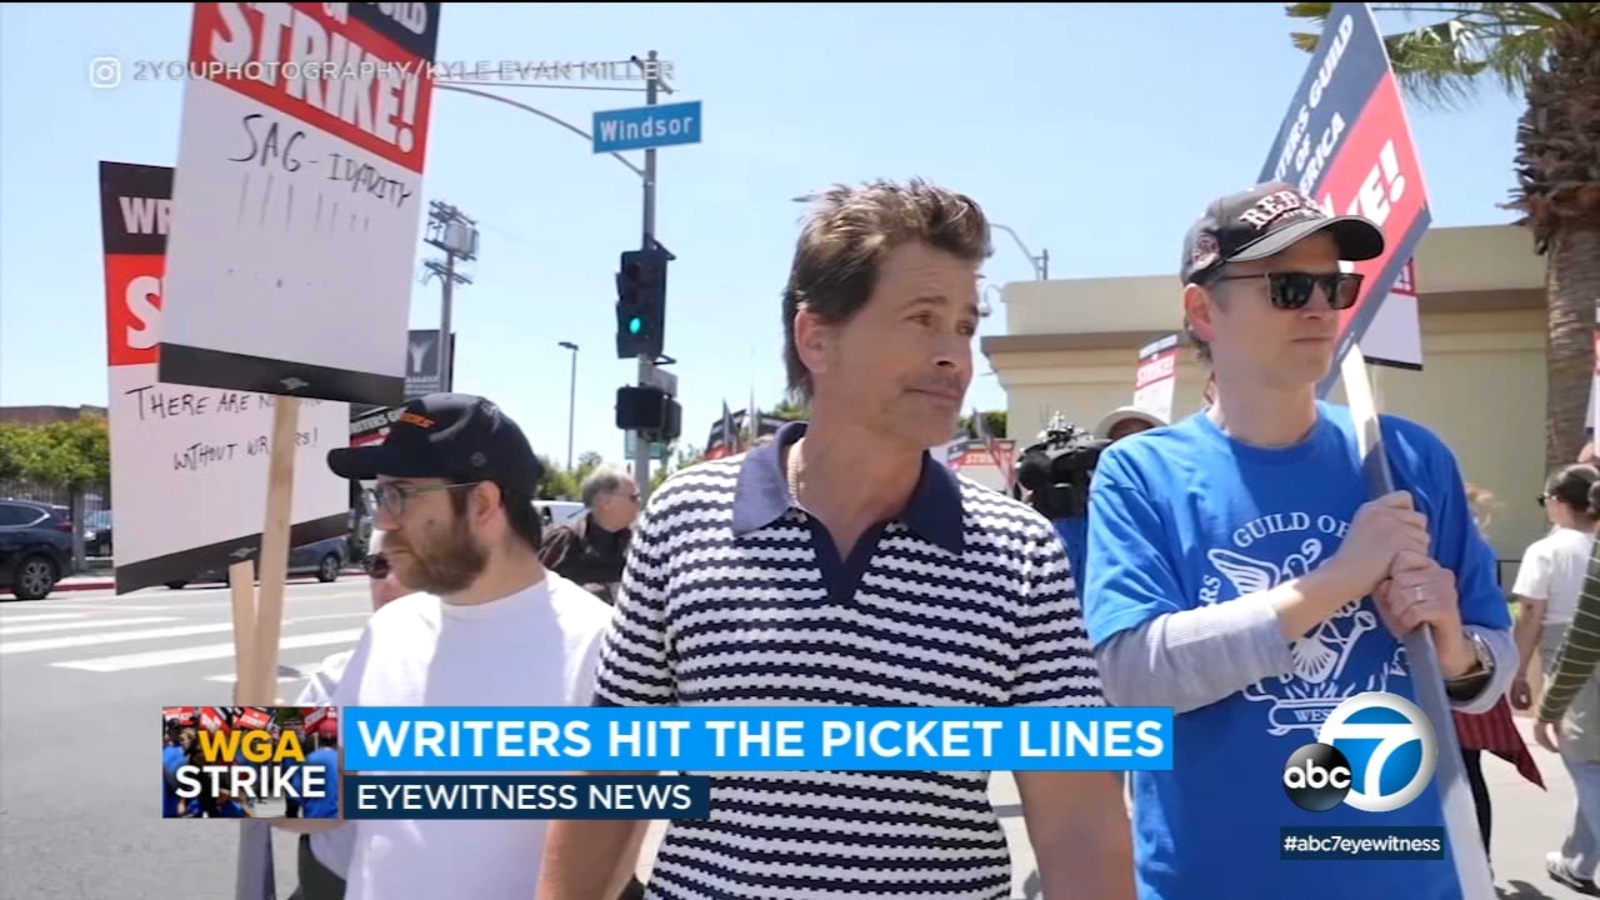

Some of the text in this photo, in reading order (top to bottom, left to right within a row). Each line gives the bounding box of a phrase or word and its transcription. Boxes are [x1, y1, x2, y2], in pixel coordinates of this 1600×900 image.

[210, 3, 420, 154] STRIKE!
[1309, 14, 1354, 109] GUILD
[600, 115, 693, 142] Windsor
[1239, 190, 1301, 231] RED
[125, 385, 210, 421] THERE
[216, 393, 251, 414] ARE
[173, 442, 238, 471] WITHOUT
[1233, 511, 1310, 548] GUILD
[1293, 708, 1334, 723] WES
